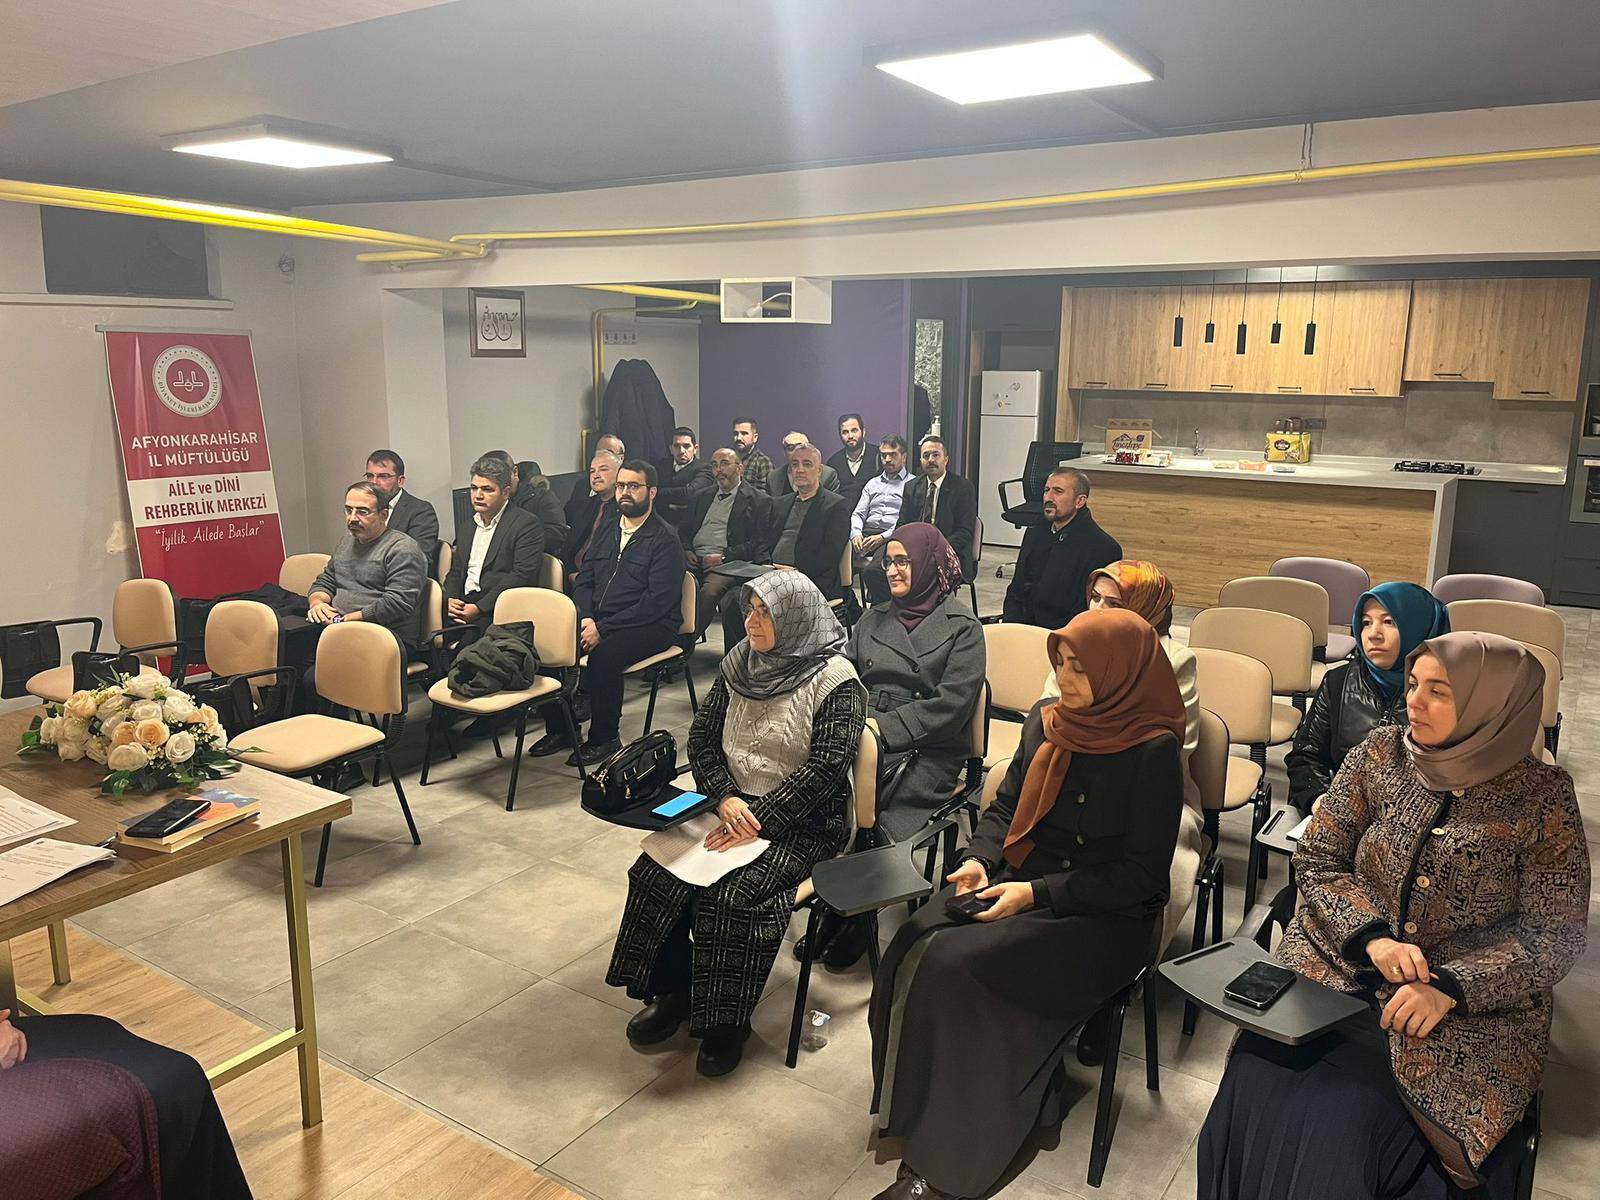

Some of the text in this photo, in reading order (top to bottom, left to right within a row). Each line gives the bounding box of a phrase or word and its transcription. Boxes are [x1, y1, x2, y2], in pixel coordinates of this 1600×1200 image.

[131, 430, 258, 449] AFYONKARAHİSAR
[148, 447, 250, 467] İL MÜFTÜLÜĞÜ
[168, 476, 240, 497] AİLE ve DİNİ
[144, 493, 267, 520] REHBERLİK MERKEZİ
[192, 525, 224, 543] Ailede
